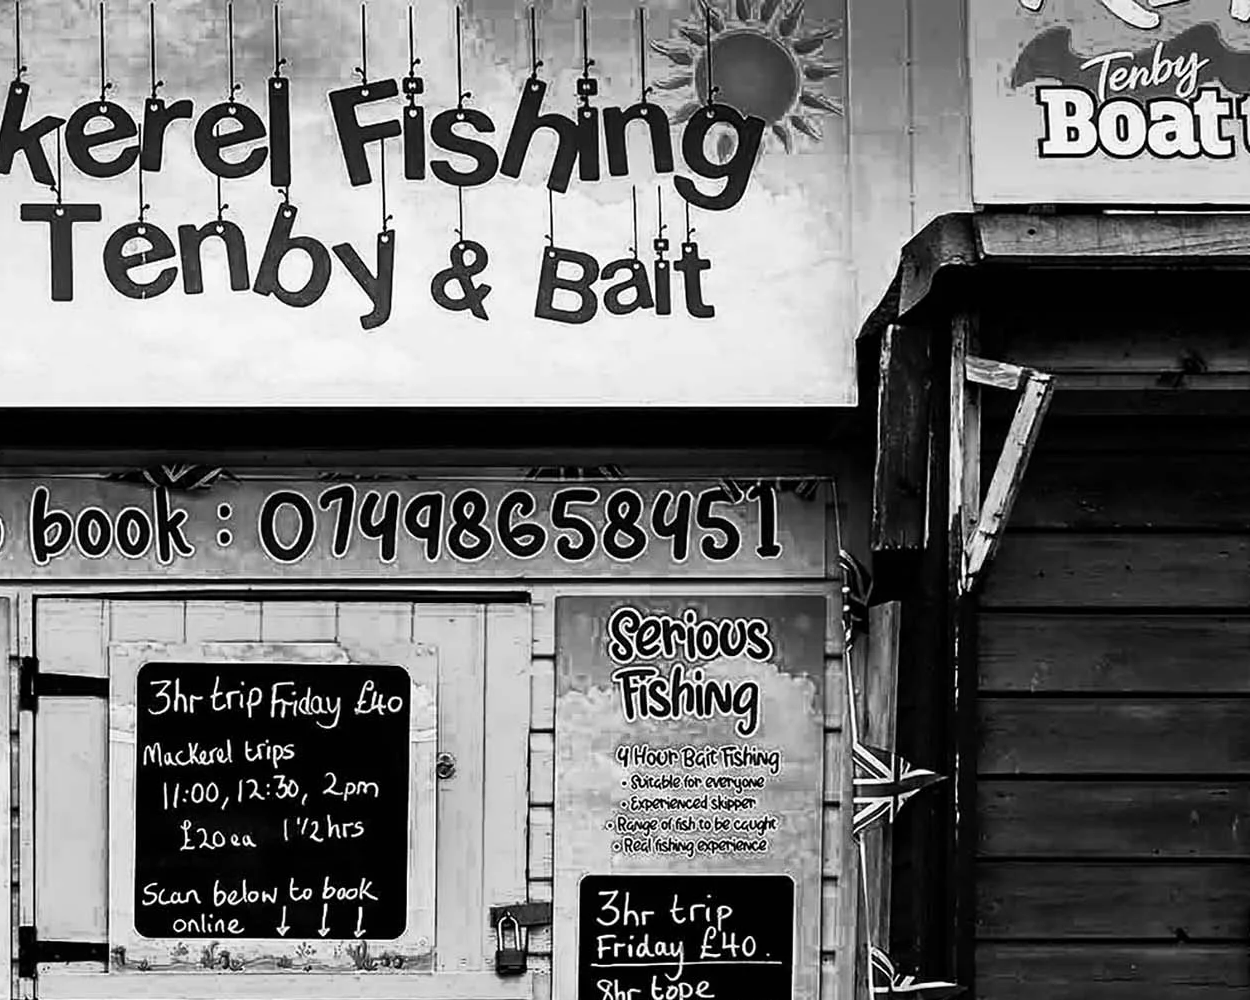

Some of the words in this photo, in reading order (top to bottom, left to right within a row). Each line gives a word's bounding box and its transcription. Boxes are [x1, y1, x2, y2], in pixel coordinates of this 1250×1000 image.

[1080, 41, 1210, 100] Tenby
[1036, 85, 1236, 159] Boat
[328, 77, 765, 210] Fishing
[21, 203, 395, 330] Tenby
[430, 240, 491, 321] &
[535, 238, 715, 324] Bait
[30, 486, 194, 565] book
[258, 484, 784, 563] 07498658451
[611, 607, 773, 662] Serious
[148, 677, 204, 715] 3hr
[210, 676, 263, 718] trip
[270, 681, 342, 729] Friday
[354, 680, 404, 715] £40
[613, 664, 760, 736] Fishing
[143, 739, 234, 767] Mackerel
[244, 739, 296, 769] trips
[617, 747, 630, 768] 4
[634, 747, 679, 766] Hour
[682, 747, 719, 768] Bait
[722, 746, 781, 775] Fishing
[238, 774, 308, 806] 12:30,
[322, 772, 380, 802] 2pm
[630, 775, 680, 790] Suitable
[684, 775, 702, 790] for
[705, 777, 765, 794] everyone
[630, 796, 708, 812] Experienced
[711, 796, 757, 814] skipper
[617, 817, 659, 836] Range
[675, 816, 696, 831] fish
[733, 817, 778, 837] caught
[623, 838, 651, 853] Real
[654, 838, 694, 858] fishing
[697, 838, 768, 855] experience
[142, 881, 202, 907] Scan
[213, 879, 278, 907] below
[289, 877, 313, 902] to
[322, 876, 379, 901] book
[597, 890, 655, 927] 3hr
[670, 894, 733, 931] trip
[173, 913, 245, 935] online
[596, 932, 685, 981] Friday
